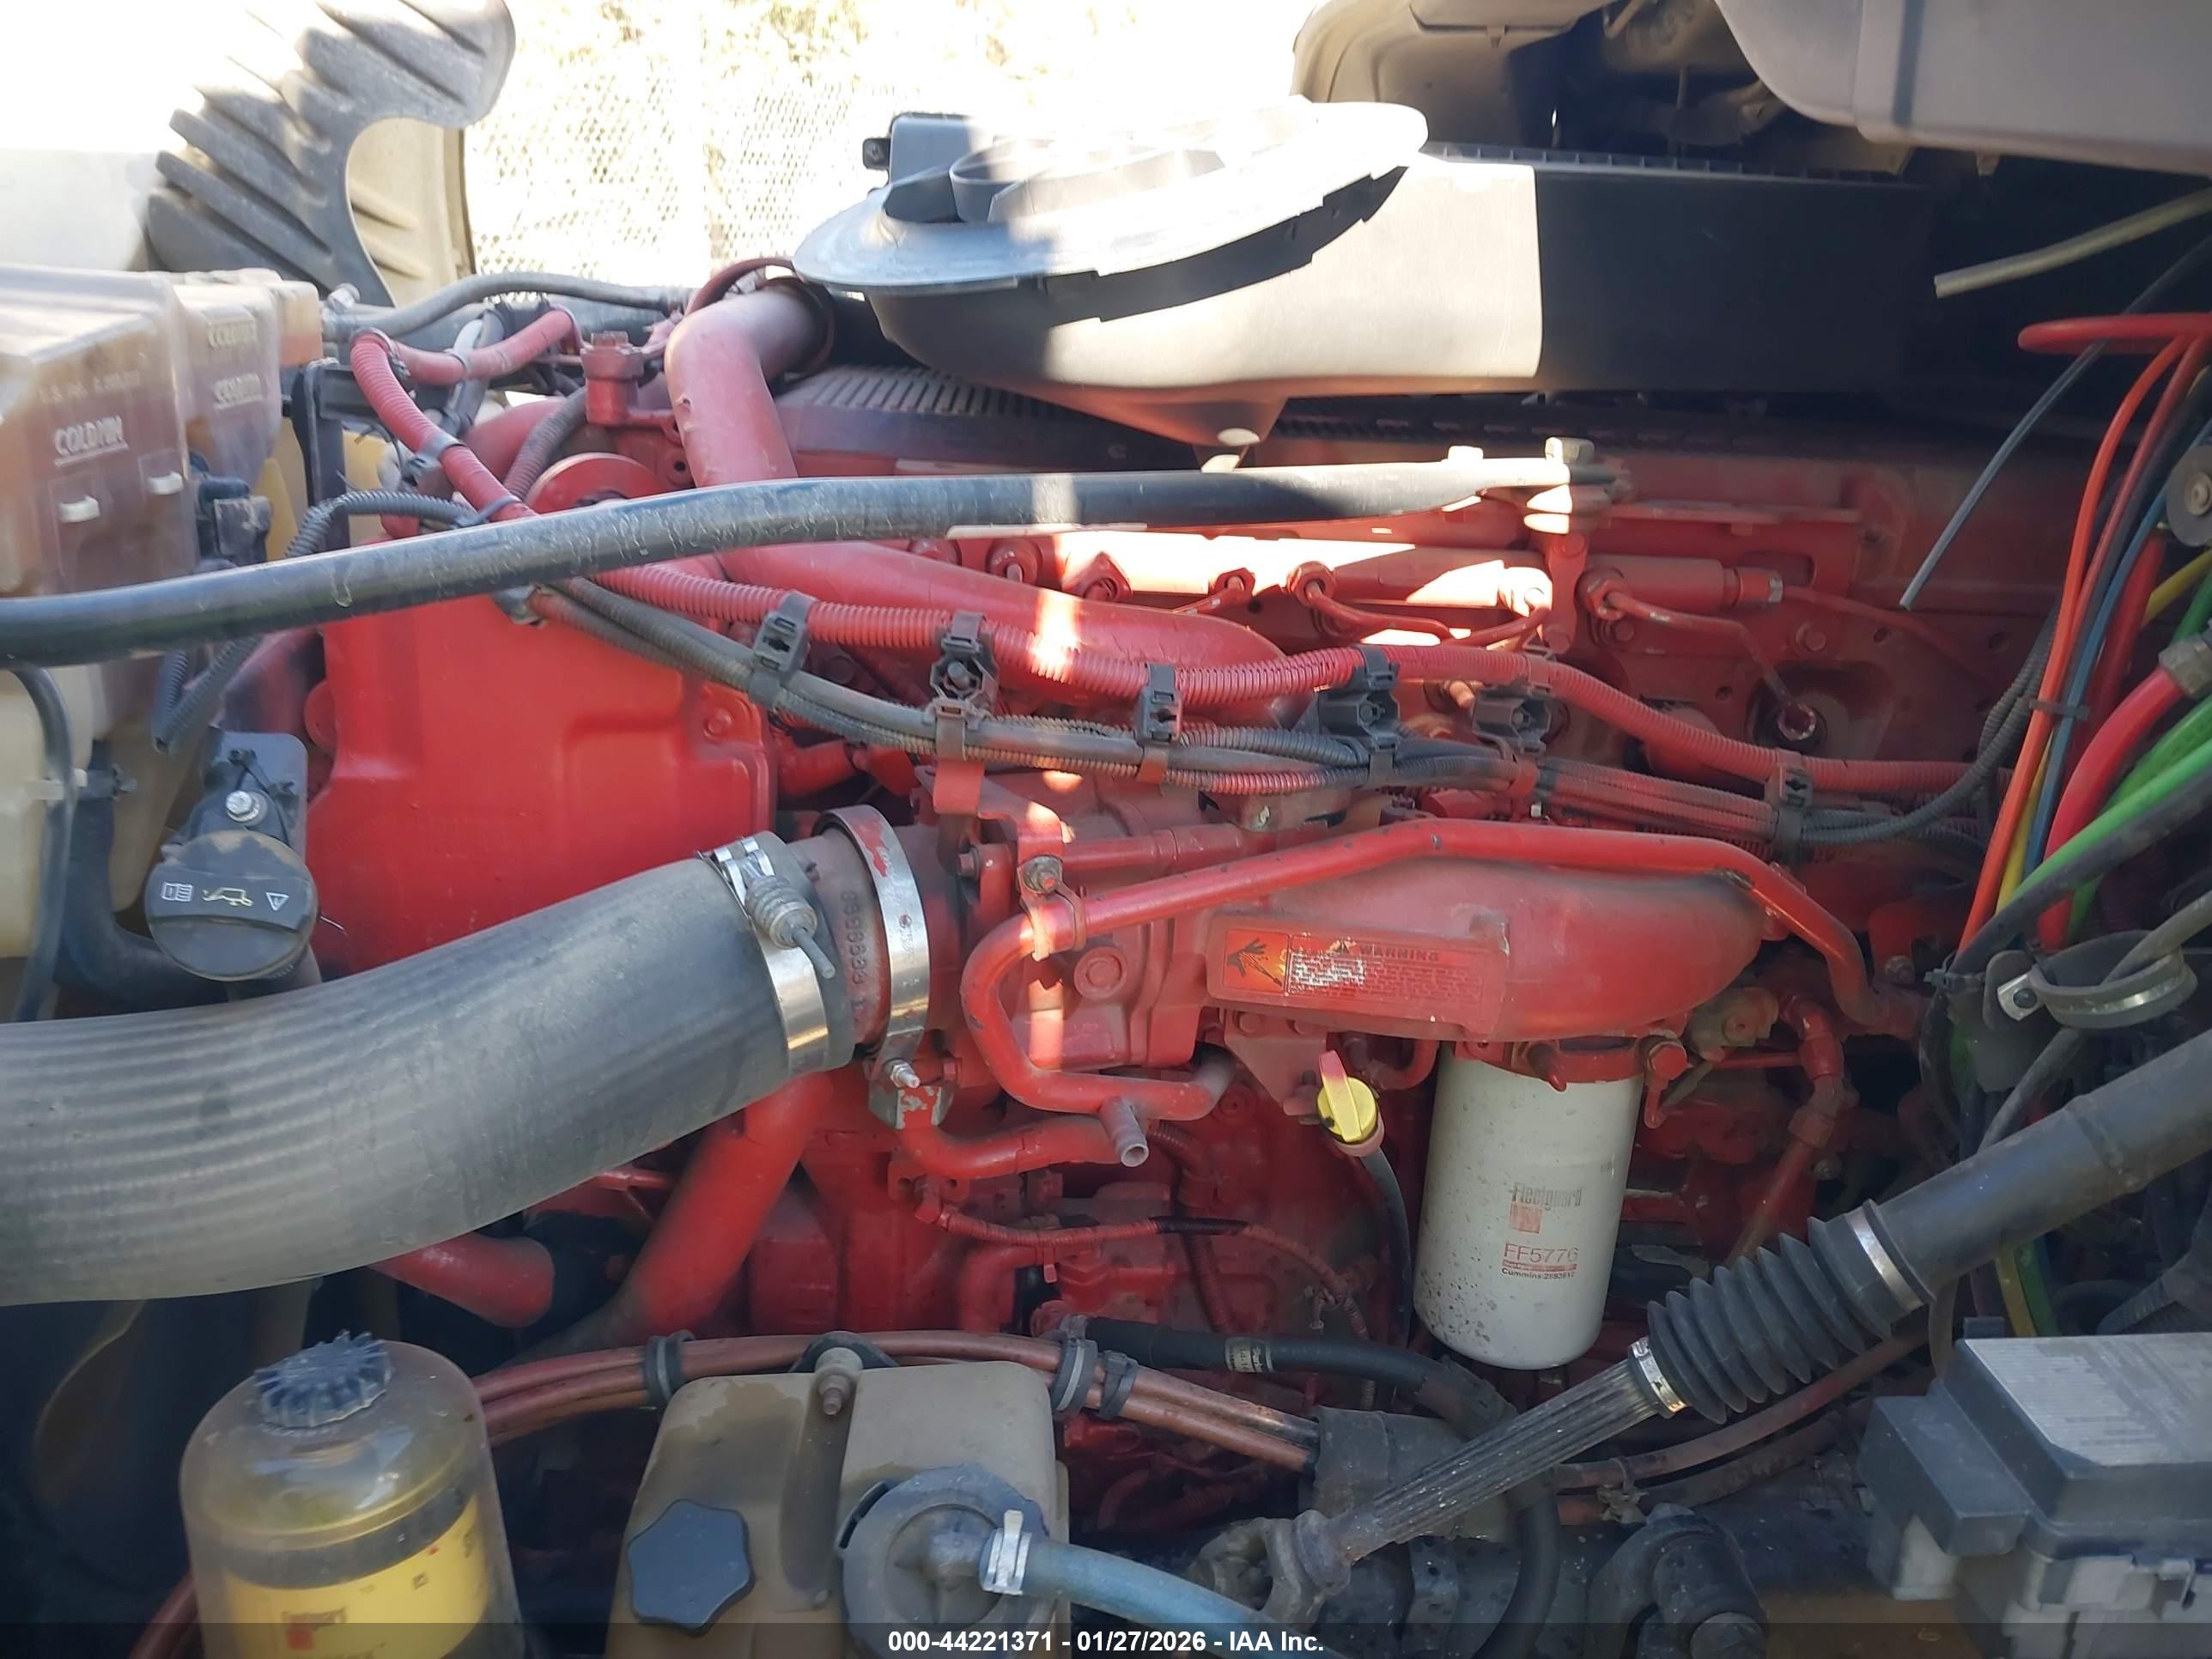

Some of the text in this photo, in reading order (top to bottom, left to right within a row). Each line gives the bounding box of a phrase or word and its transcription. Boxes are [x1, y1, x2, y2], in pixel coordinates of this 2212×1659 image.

[1358, 944, 1438, 963] WARNING
[1510, 1182, 1583, 1211] Fleetguard
[1504, 1243, 1579, 1263] FF5776
[1501, 1267, 1541, 1279] Cummins
